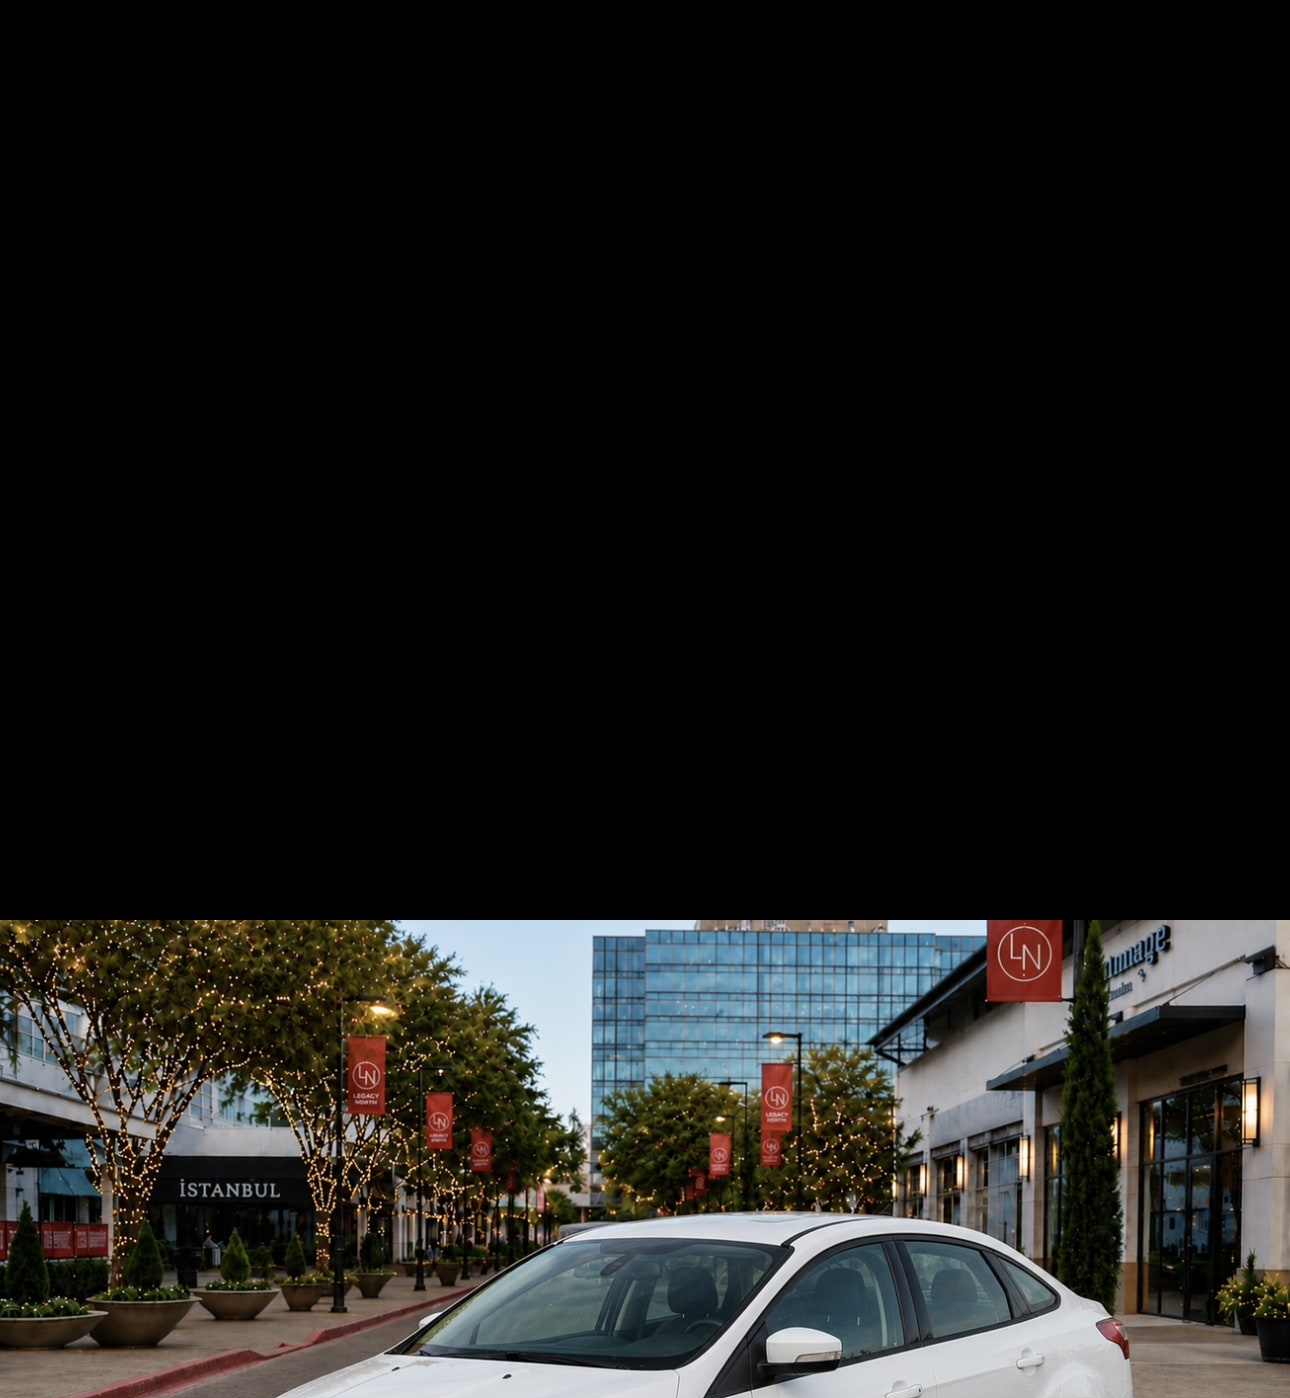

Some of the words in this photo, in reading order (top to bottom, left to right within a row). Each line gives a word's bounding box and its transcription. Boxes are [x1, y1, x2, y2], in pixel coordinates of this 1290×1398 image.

[1010, 933, 1041, 970] LN
[359, 1065, 376, 1086] LN
[770, 1090, 786, 1106] LN
